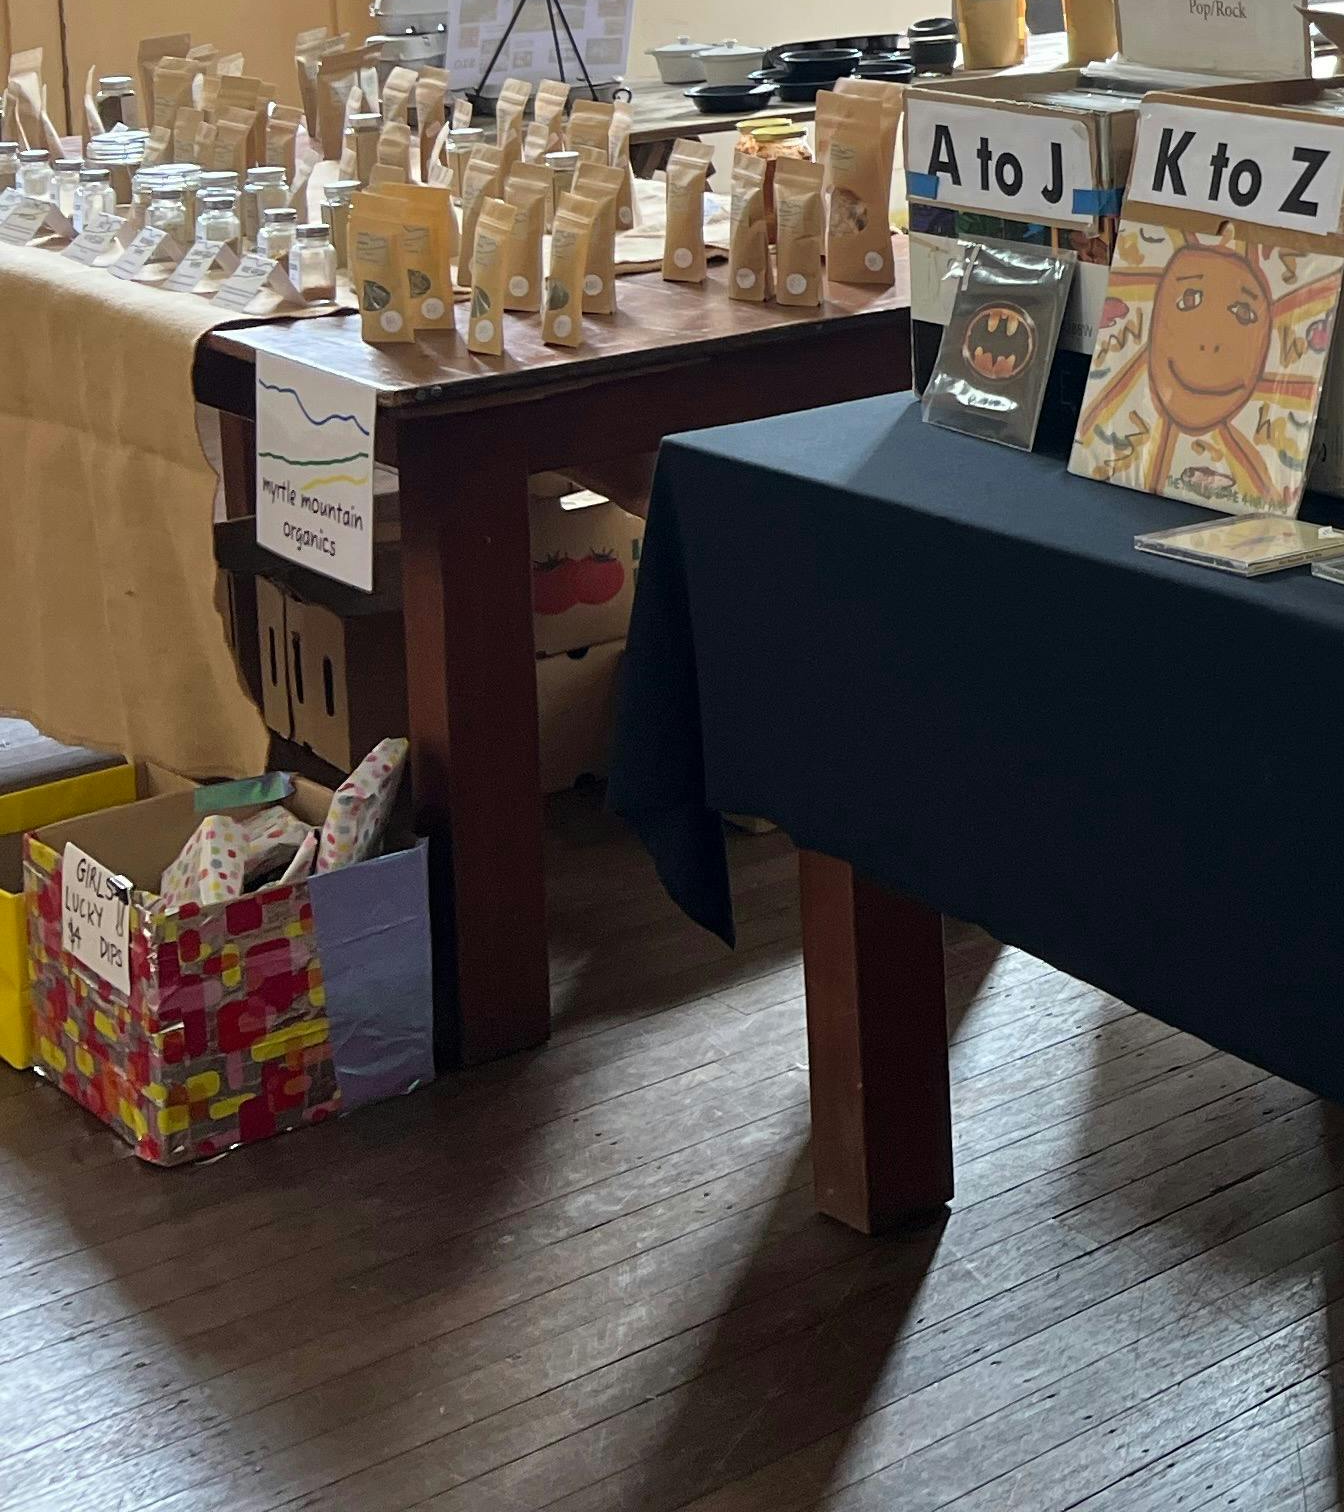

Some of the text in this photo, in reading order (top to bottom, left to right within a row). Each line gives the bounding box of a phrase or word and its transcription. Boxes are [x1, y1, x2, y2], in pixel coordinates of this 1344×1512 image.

[927, 124, 1063, 204] A to J
[1151, 128, 1331, 217] K to Z
[262, 475, 364, 531] myrtle mountain
[283, 519, 337, 557] organics
[77, 858, 114, 900] GIRLS
[65, 885, 103, 928] LUCKY
[100, 935, 122, 967] DIPS
